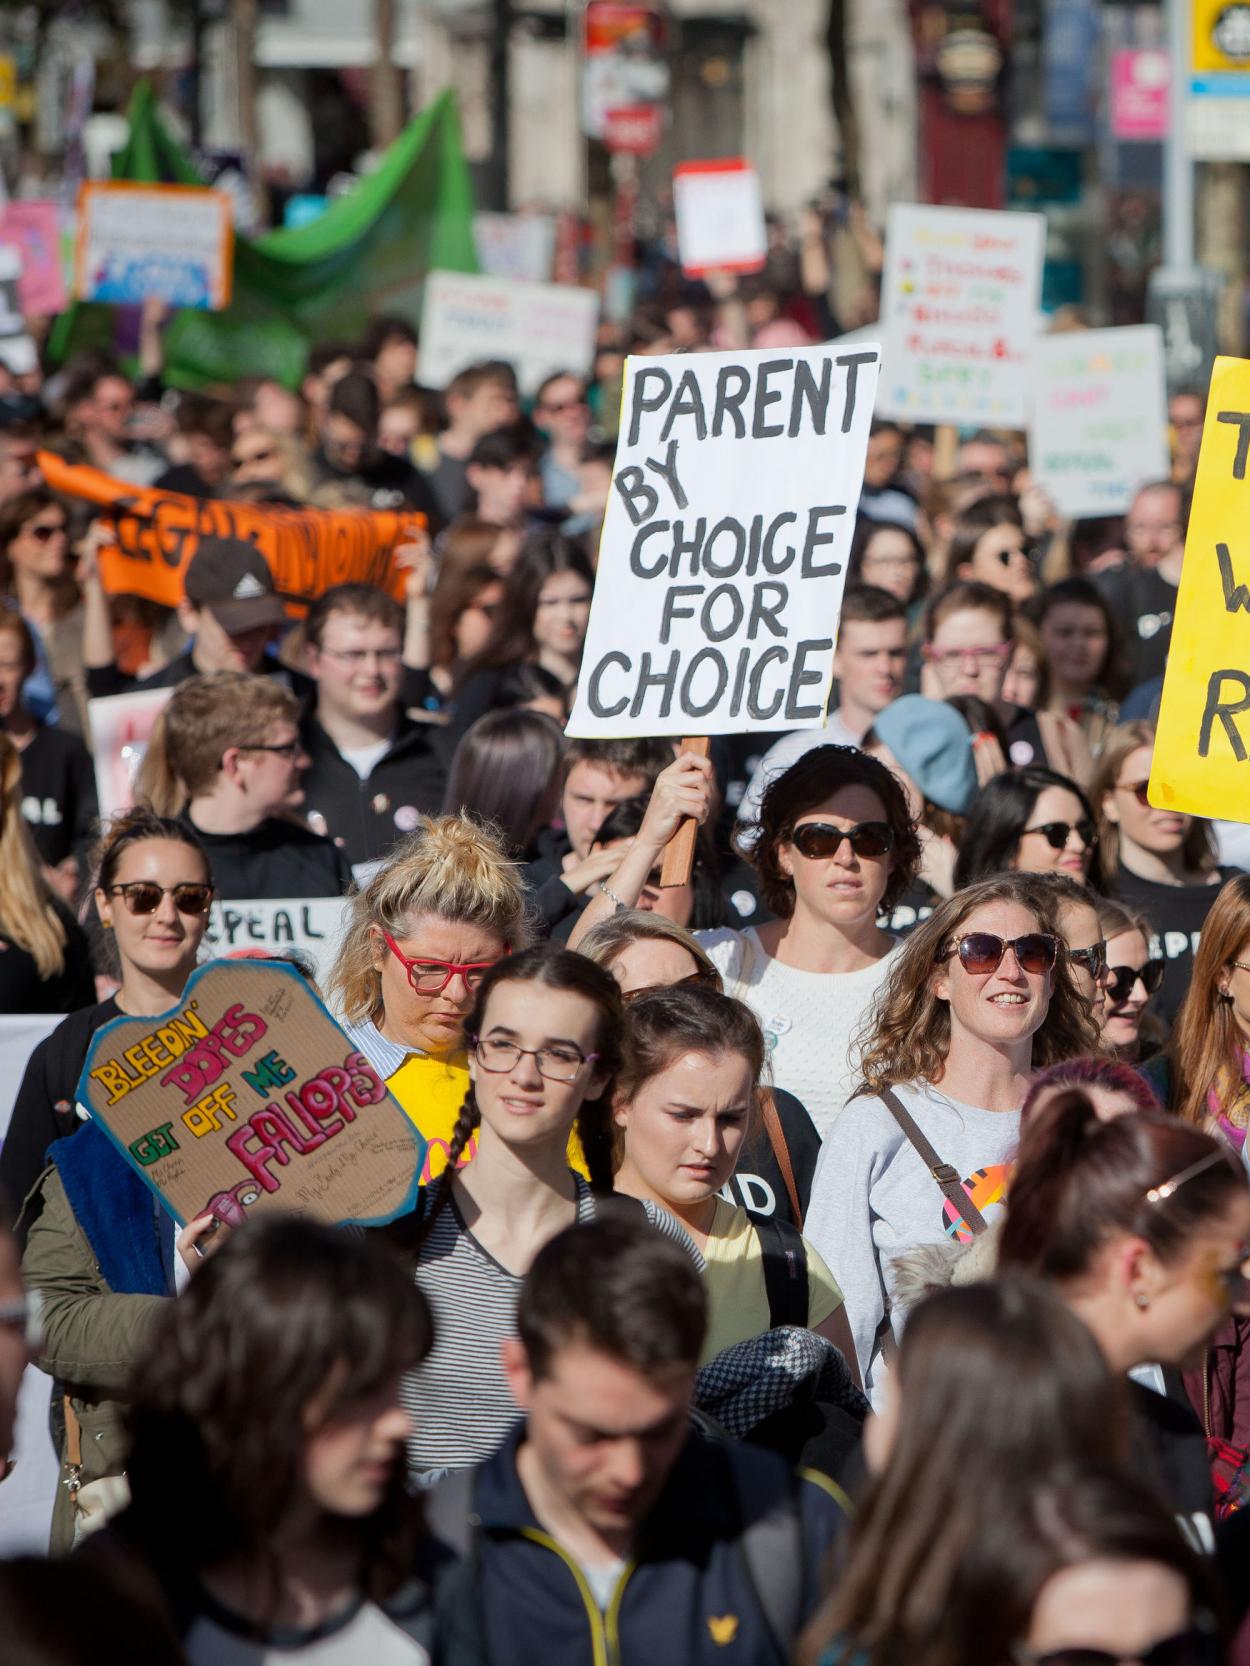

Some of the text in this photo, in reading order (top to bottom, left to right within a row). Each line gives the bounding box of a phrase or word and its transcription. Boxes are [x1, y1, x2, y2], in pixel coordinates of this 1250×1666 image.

[628, 352, 878, 447] PARENT
[615, 439, 688, 526] BY
[629, 505, 847, 579] CHOICE
[658, 581, 789, 644] FOR
[588, 638, 833, 720] CHOICE
[89, 1000, 210, 1106] BLEEDIN'
[128, 1050, 297, 1166] GET OFF ME
[225, 1051, 389, 1194] FALLOPES
